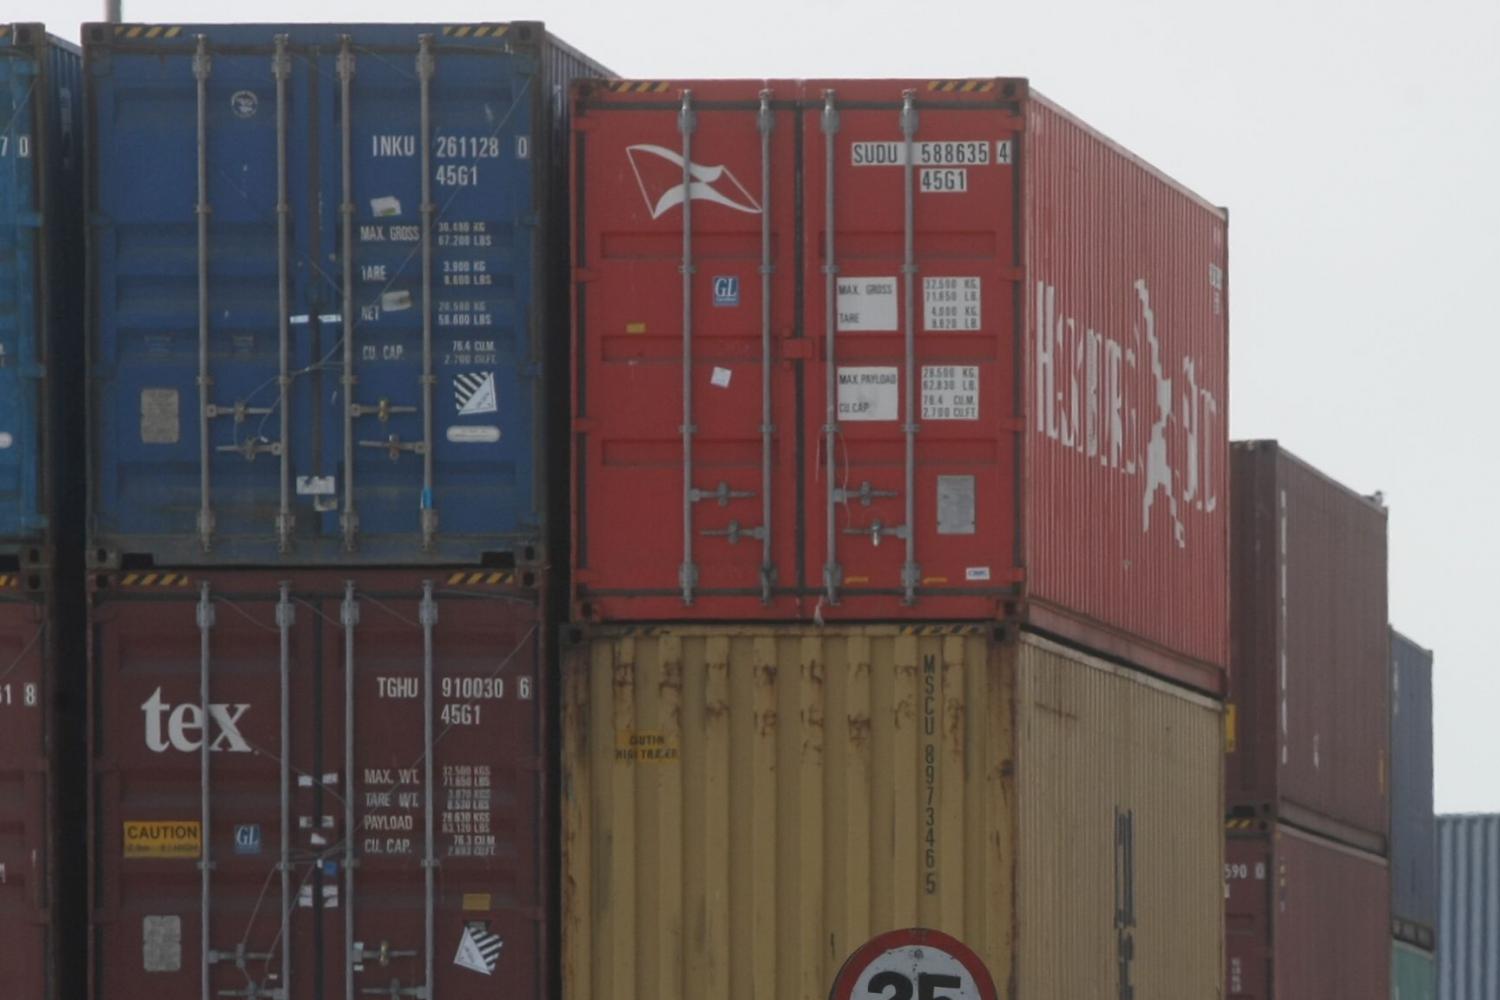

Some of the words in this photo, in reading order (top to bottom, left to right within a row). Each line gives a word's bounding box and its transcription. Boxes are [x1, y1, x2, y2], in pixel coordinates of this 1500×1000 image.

[372, 135, 415, 157] INKU
[436, 136, 499, 159] 261128
[517, 137, 528, 158] 0
[853, 143, 898, 165] SUDU
[921, 143, 988, 163] 588635
[999, 142, 1008, 162] 4
[436, 165, 478, 186] 45G1
[922, 170, 965, 190] 45G1
[389, 225, 420, 241] GROSS
[865, 284, 893, 295] GROSS
[839, 312, 860, 324] TARE
[376, 676, 418, 699] TGHU
[441, 677, 504, 699] 910030
[519, 677, 530, 699] 6
[923, 653, 936, 736] MSCU
[140, 685, 252, 753] tex
[440, 703, 481, 725] 45G1
[365, 792, 391, 807] TARE
[924, 743, 936, 869] 897346
[126, 825, 198, 840] CAUTION
[363, 815, 413, 830] PAYLOAD
[235, 825, 259, 846] GL
